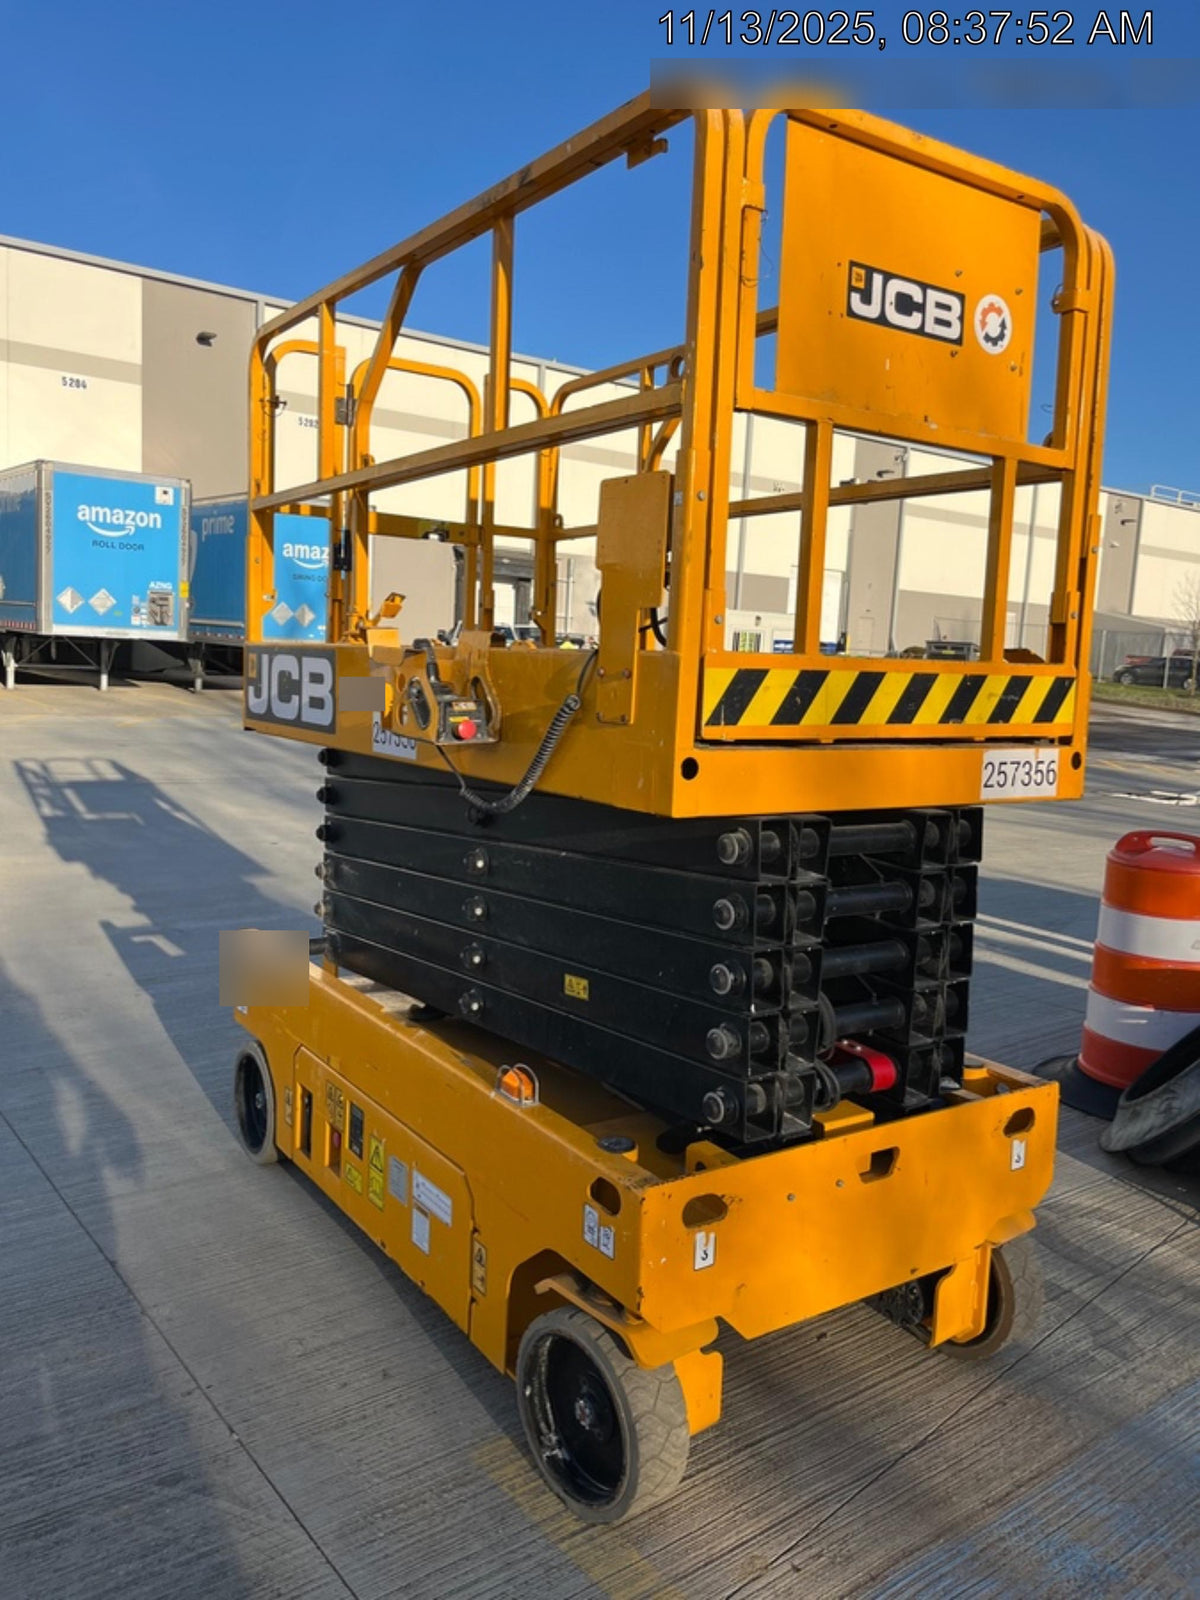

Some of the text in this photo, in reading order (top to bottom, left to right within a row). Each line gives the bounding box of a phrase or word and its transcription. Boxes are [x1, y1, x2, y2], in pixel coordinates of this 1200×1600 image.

[850, 272, 963, 340] JCB
[77, 504, 162, 530] amazon
[202, 511, 235, 542] prime
[92, 539, 145, 552] ROLL DOOR
[282, 542, 330, 561] amaz
[247, 653, 334, 726] JCB
[983, 760, 1057, 788] 257356
